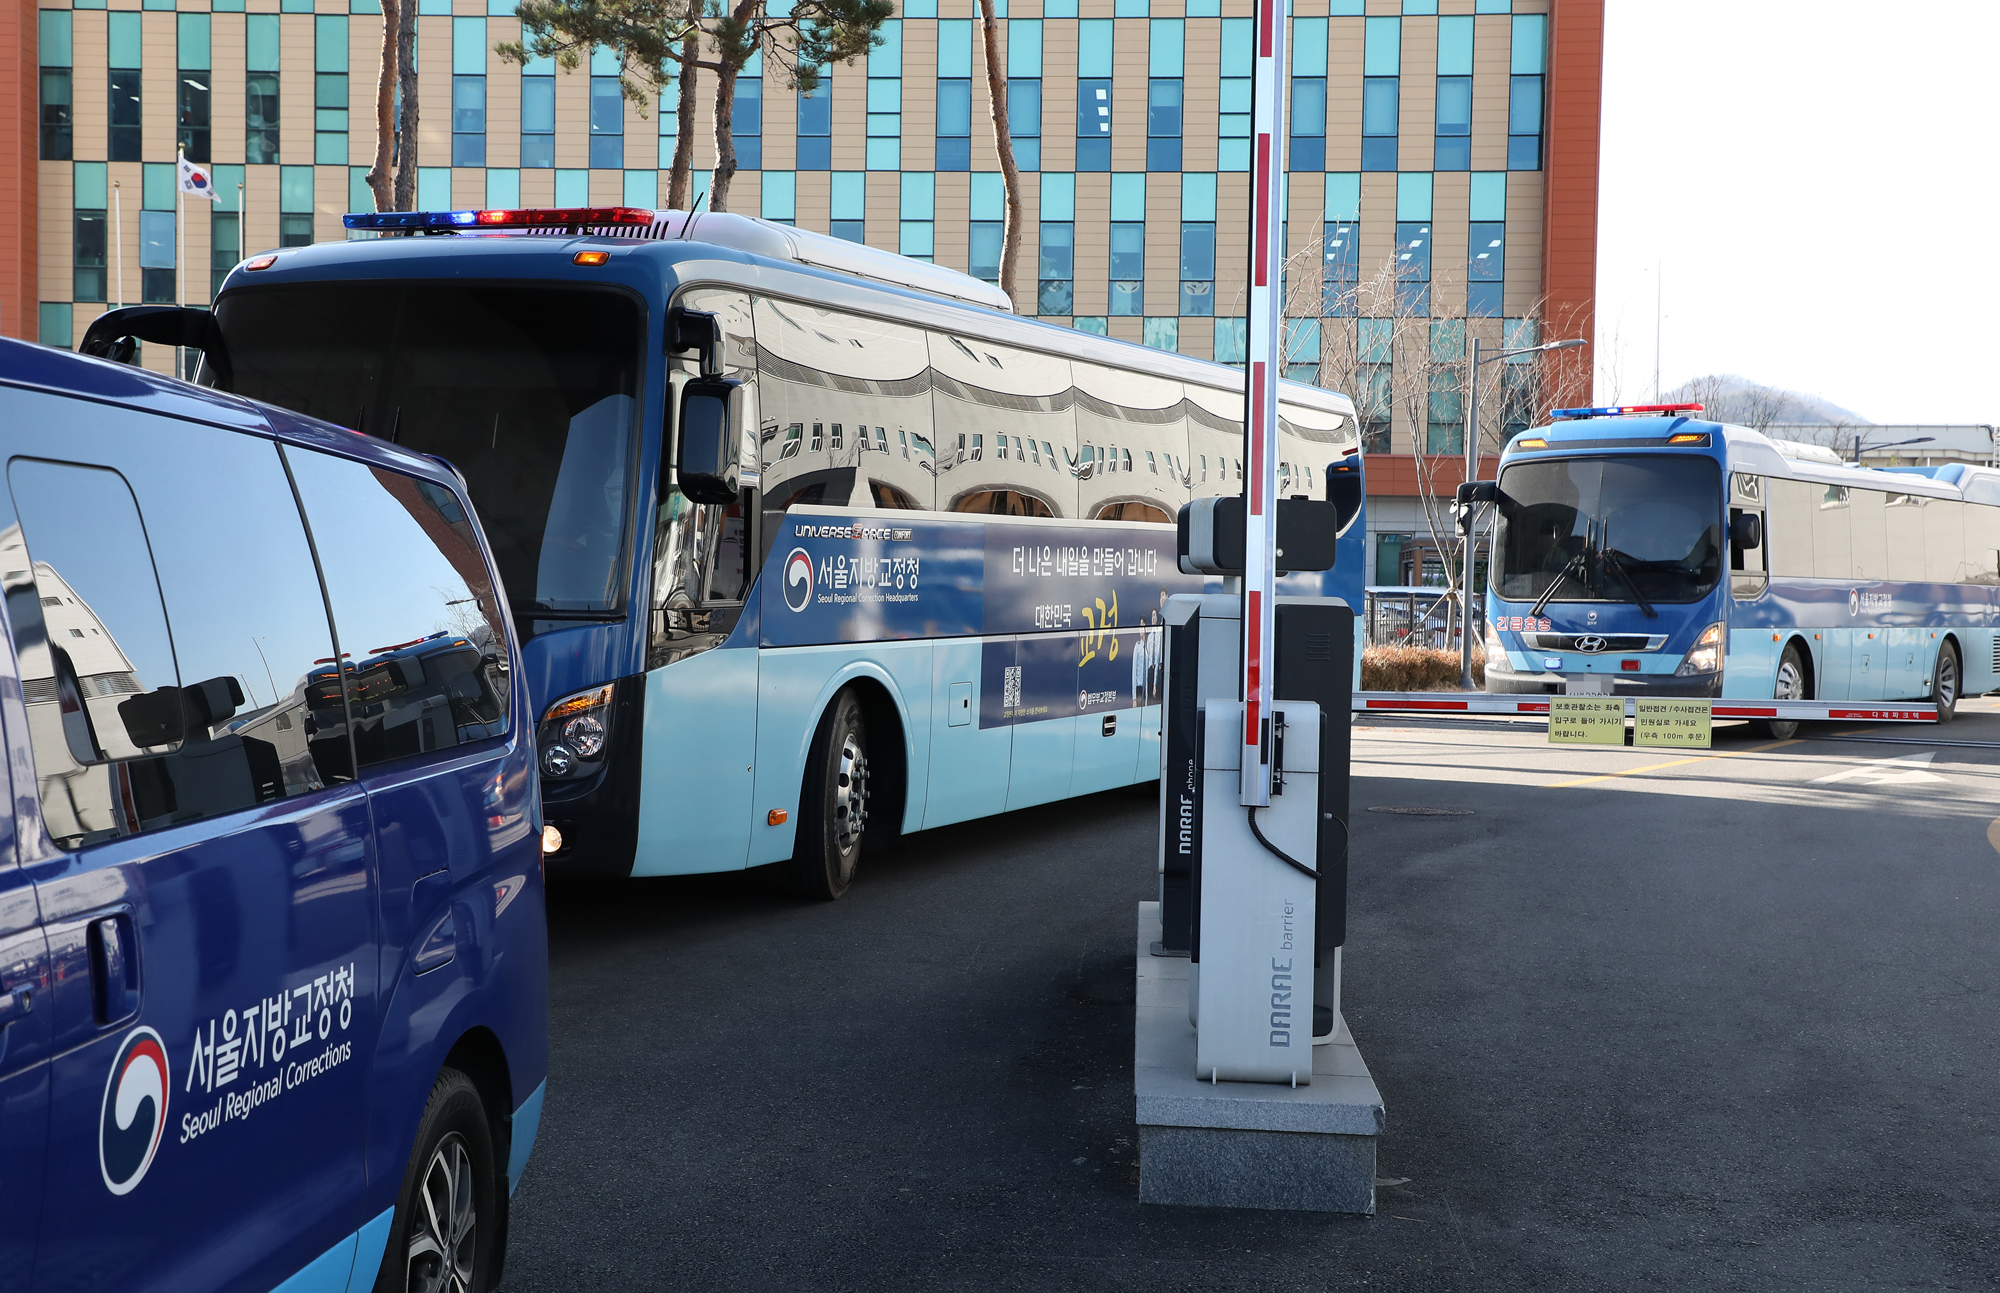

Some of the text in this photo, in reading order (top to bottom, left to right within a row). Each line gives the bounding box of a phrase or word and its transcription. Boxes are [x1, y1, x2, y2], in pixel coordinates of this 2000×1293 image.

[1012, 545, 1158, 577] 더 나은 내일을 만들어 갑니다
[818, 555, 920, 590] 서울지방교정청
[817, 593, 919, 605] Seoul Regional Correction Headquarters
[1860, 592, 1892, 607] 서울지방교정청
[1034, 589, 1119, 667] 대한민국 교정
[1496, 616, 1552, 632] 긴급호송
[1555, 703, 1602, 712] 보호관찰소는
[1605, 704, 1621, 712] 좌측
[1638, 705, 1667, 713] 일반접견
[1554, 716, 1622, 726] 입구로 들어 가시기
[1640, 718, 1697, 727] 민원실로 가세요
[1554, 730, 1588, 738] 바랍니다.
[1640, 732, 1658, 740] (우측
[1687, 733, 1706, 741] 후문)
[1269, 899, 1294, 1048] DARAE barrier
[185, 962, 355, 1093] 서울지방교정청
[180, 1040, 352, 1144] Seoul Regional Corrections
